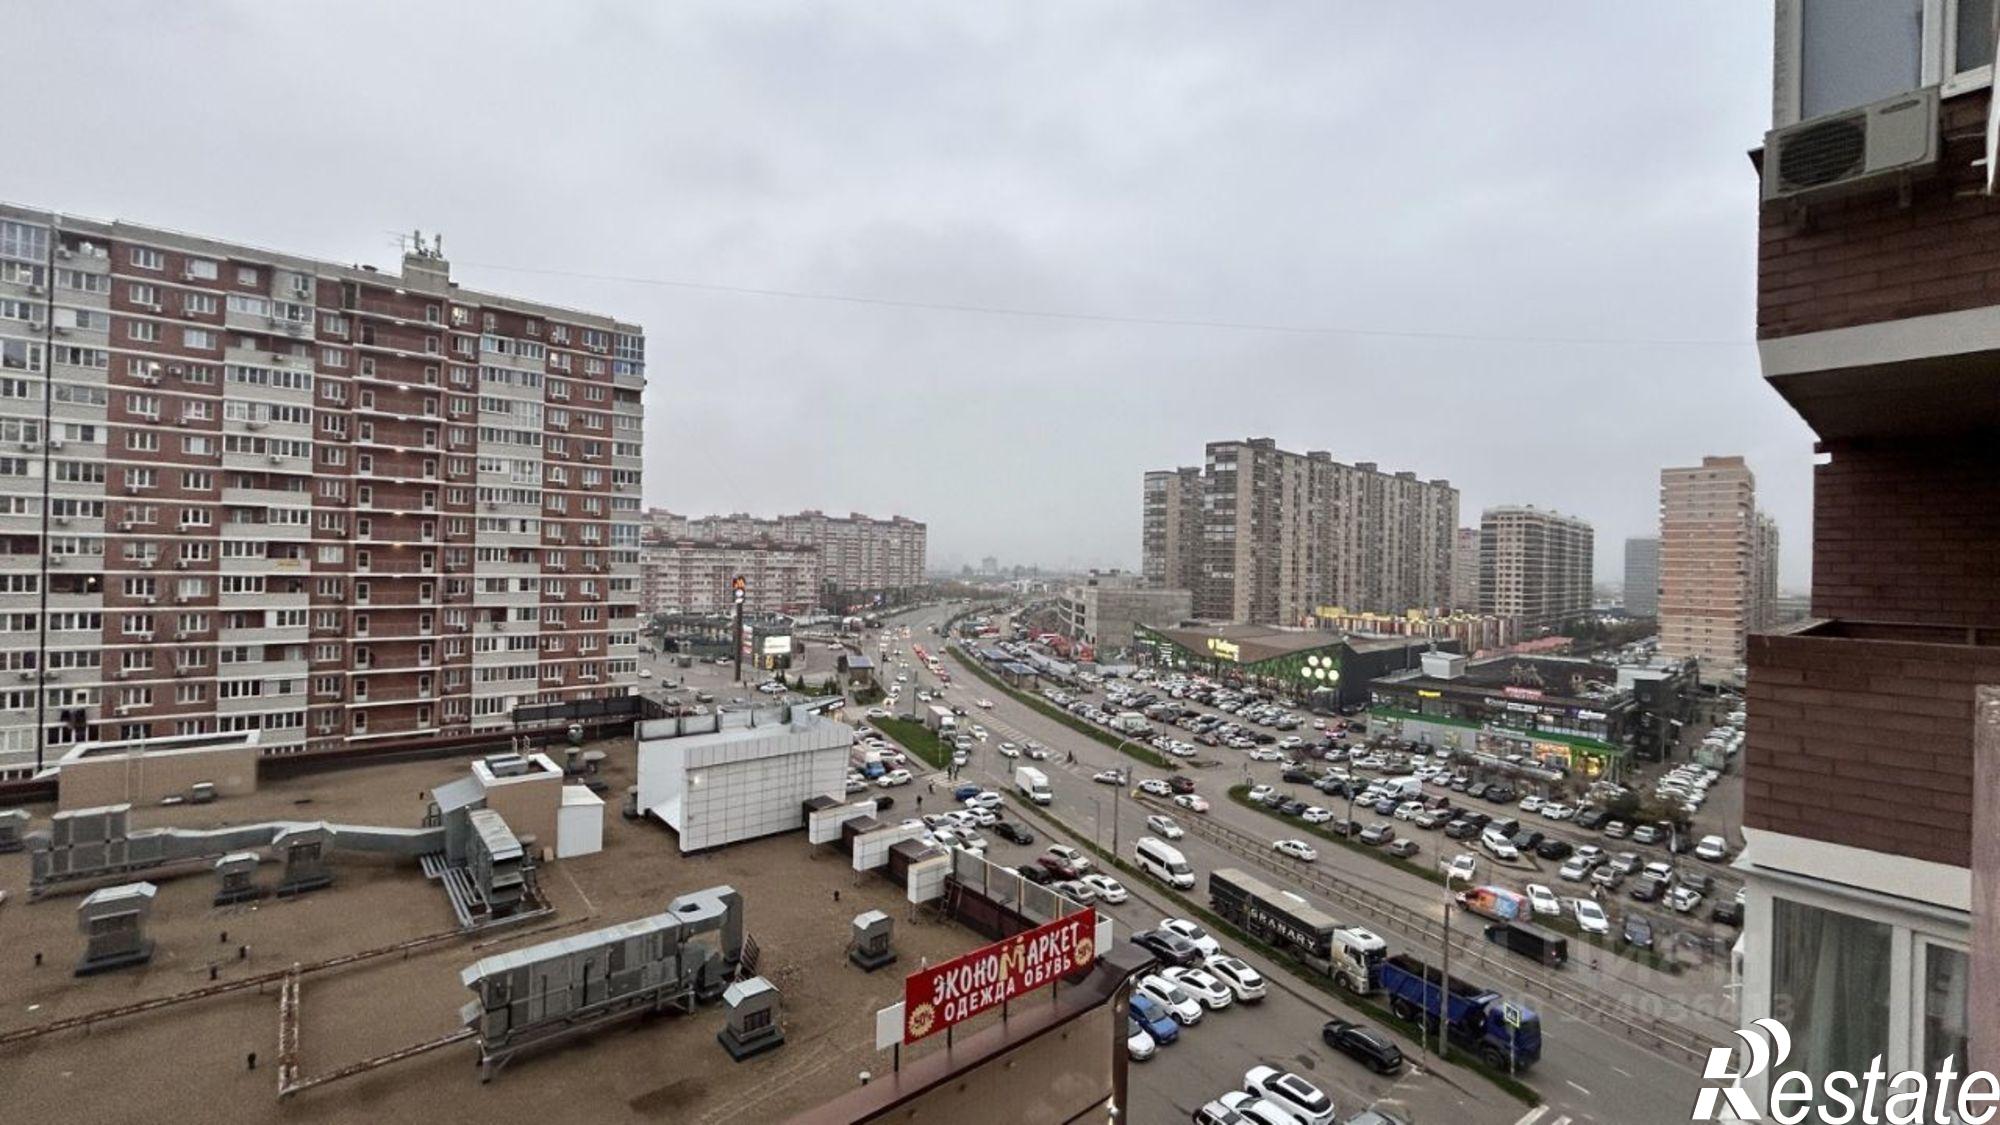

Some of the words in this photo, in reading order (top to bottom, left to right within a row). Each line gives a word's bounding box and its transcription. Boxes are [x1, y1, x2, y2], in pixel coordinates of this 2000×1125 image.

[1250, 908, 1315, 949] GRANARY
[933, 922, 1079, 1005] ЭКОНОМАРКЕТ
[944, 979, 1015, 1021] ОДЕЖДА
[1024, 955, 1071, 987] ОБУВЬ
